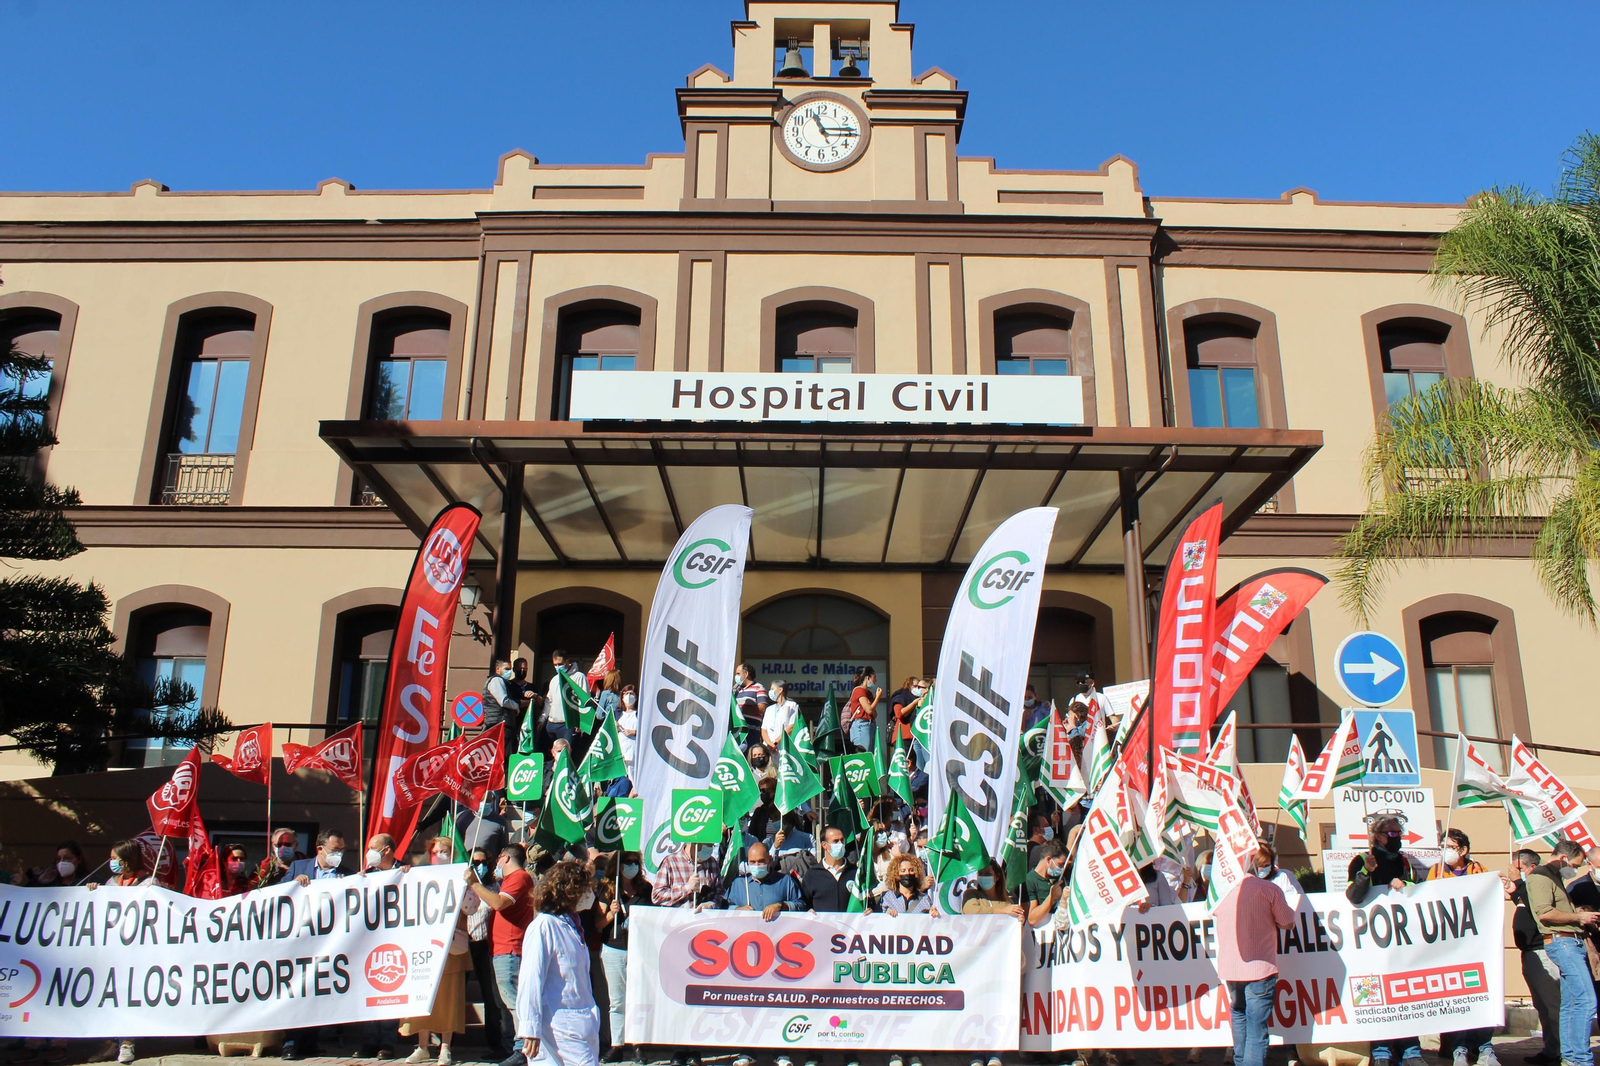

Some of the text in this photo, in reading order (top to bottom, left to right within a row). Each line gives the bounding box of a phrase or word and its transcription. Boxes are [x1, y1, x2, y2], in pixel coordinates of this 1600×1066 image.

[805, 108, 813, 118] 11
[817, 104, 828, 115] 12
[833, 108, 837, 118] 1
[793, 115, 804, 126] 10
[842, 116, 849, 126] 2
[792, 126, 799, 137] 9
[795, 137, 803, 148] 8
[841, 139, 849, 149] 4
[805, 146, 811, 156] 7
[817, 149, 825, 160] 6
[831, 146, 839, 157] 5
[671, 379, 989, 419] Hospital Civil
[430, 534, 460, 573] UGT
[685, 552, 737, 576] CSIF
[981, 567, 1035, 591] CSIF
[1170, 575, 1205, 727] CCOO
[762, 663, 796, 675] H.R.U.
[801, 663, 818, 675] de
[786, 680, 825, 694] ospital
[651, 624, 720, 780] CSIF
[945, 649, 1011, 823] CSIF
[514, 769, 539, 783] CSIF
[715, 764, 741, 792] CSIF
[846, 768, 871, 783] CSIF
[682, 807, 717, 823] CSIF
[604, 816, 637, 831] CSIF
[1011, 819, 1027, 853] CSIF
[1088, 807, 1141, 898] CCOO
[1325, 850, 1356, 859] URGENCIAS
[1407, 850, 1442, 859] TRASLADADA
[1088, 859, 1114, 905] Málaga
[0, 900, 95, 947] LUCHA
[103, 900, 159, 946] POR
[167, 900, 199, 945] LA
[206, 891, 336, 944] SANIDAD
[1108, 923, 1126, 961] Y
[1352, 903, 1412, 949] POR
[1416, 895, 1479, 944] UNA
[829, 933, 954, 955] SANIDAD
[371, 950, 403, 969] UGT
[686, 929, 816, 981] SOS
[0, 967, 19, 981] SP
[832, 957, 956, 985] PÚBLICA
[45, 953, 351, 1008] NO A LOS RECORTES
[1389, 972, 1462, 999] CCOO
[376, 996, 401, 1005] Andalucía
[703, 990, 946, 1006] Por nuestra SALUD. Por nuestros DERECHOS.
[1020, 968, 1348, 1036] ANIDAD PÚBLICA GNA
[1354, 1006, 1396, 1016] sindicato
[1398, 1004, 1409, 1012] de
[1411, 998, 1444, 1011] sanidad
[1453, 994, 1490, 1005] sectores
[1356, 1005, 1471, 1025] sociosanitarios de Málaga
[788, 1023, 812, 1034] CSIF
[839, 1031, 865, 1039] contigo
